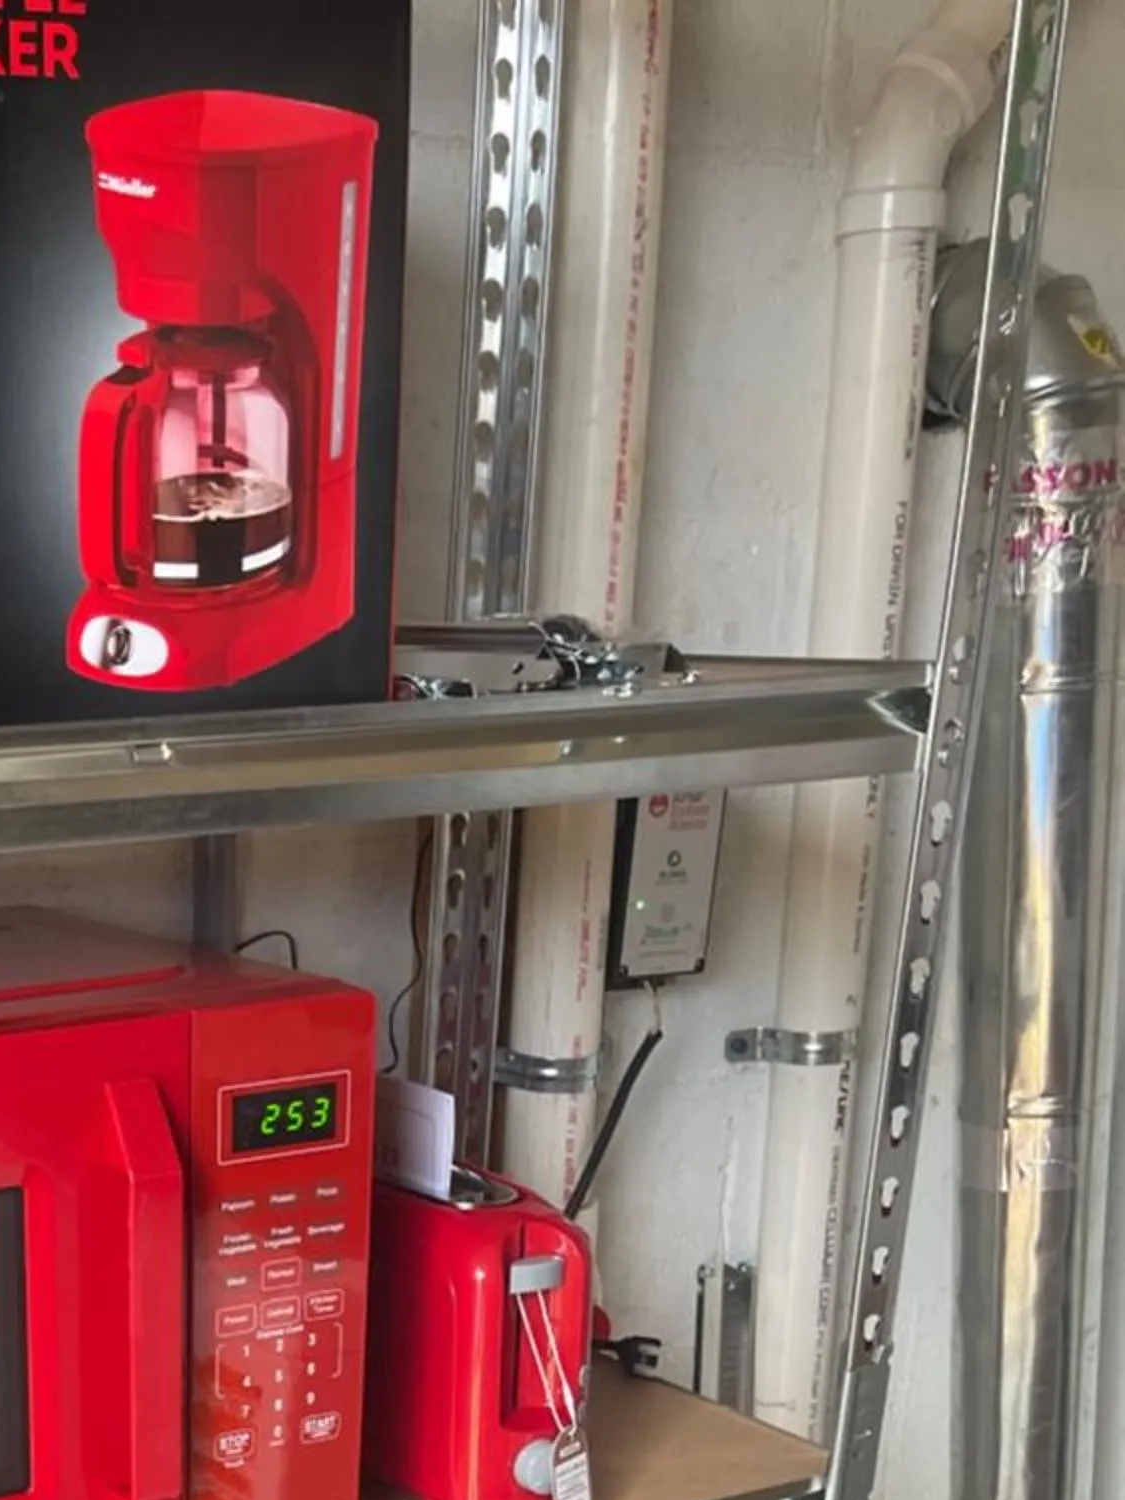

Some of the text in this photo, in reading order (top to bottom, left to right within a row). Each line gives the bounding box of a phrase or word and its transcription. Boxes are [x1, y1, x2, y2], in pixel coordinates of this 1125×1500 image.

[308, 1332, 317, 1347] 3
[242, 1374, 252, 1388] 4
[218, 1432, 251, 1451] STOP
